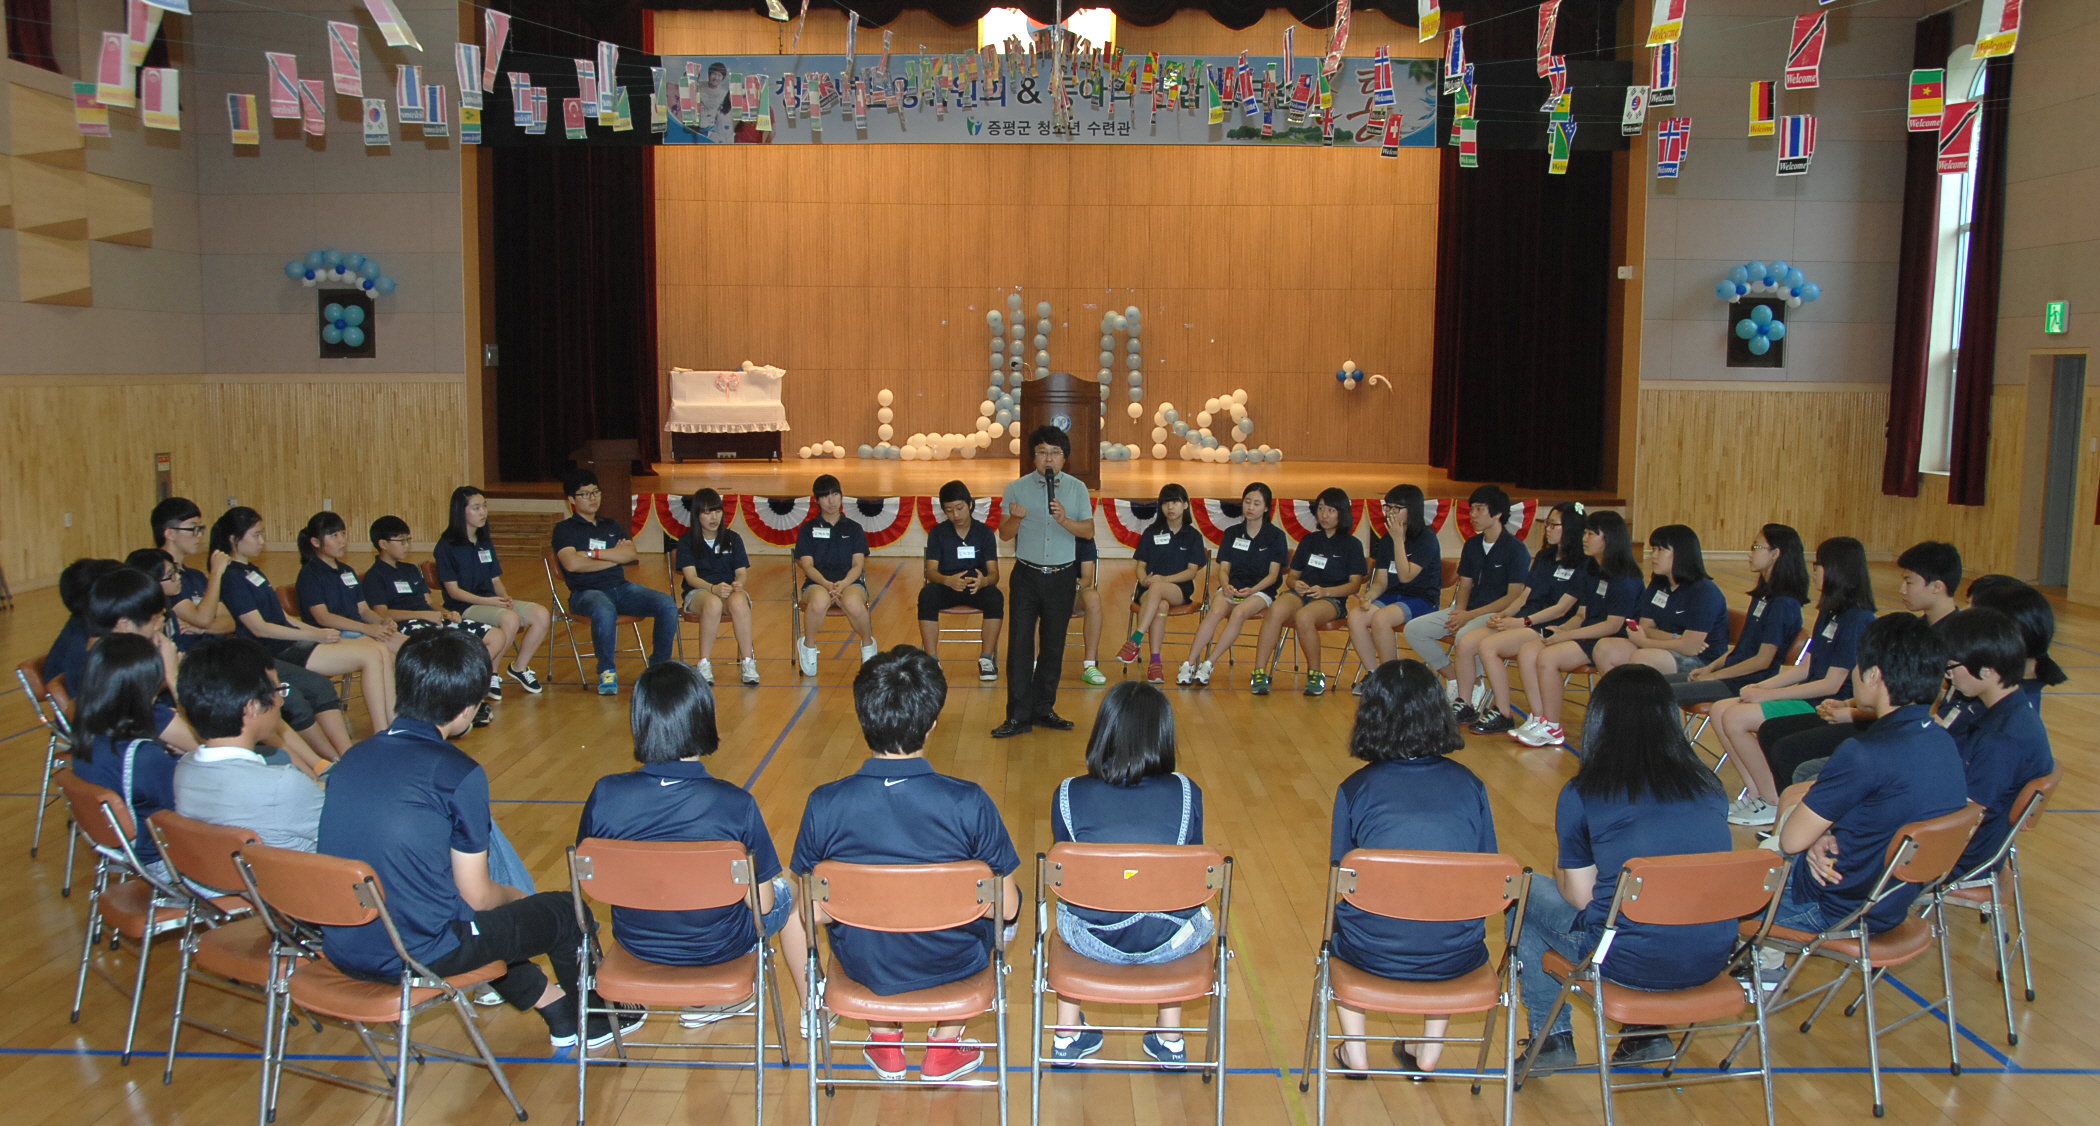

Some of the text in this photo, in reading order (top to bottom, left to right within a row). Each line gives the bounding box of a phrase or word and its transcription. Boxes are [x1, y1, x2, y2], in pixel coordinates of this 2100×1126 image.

[1650, 28, 1680, 41] Welcome
[1786, 72, 1817, 85] Welcome
[1017, 77, 1042, 105] &
[1650, 91, 1675, 103] Welcome
[987, 121, 1131, 137] 증평군 청소년 수련관
[1750, 125, 1774, 133] Welcome
[1910, 119, 1941, 128] Welcome
[1780, 161, 1807, 171] Welcome
[1938, 160, 1968, 170] Welcome
